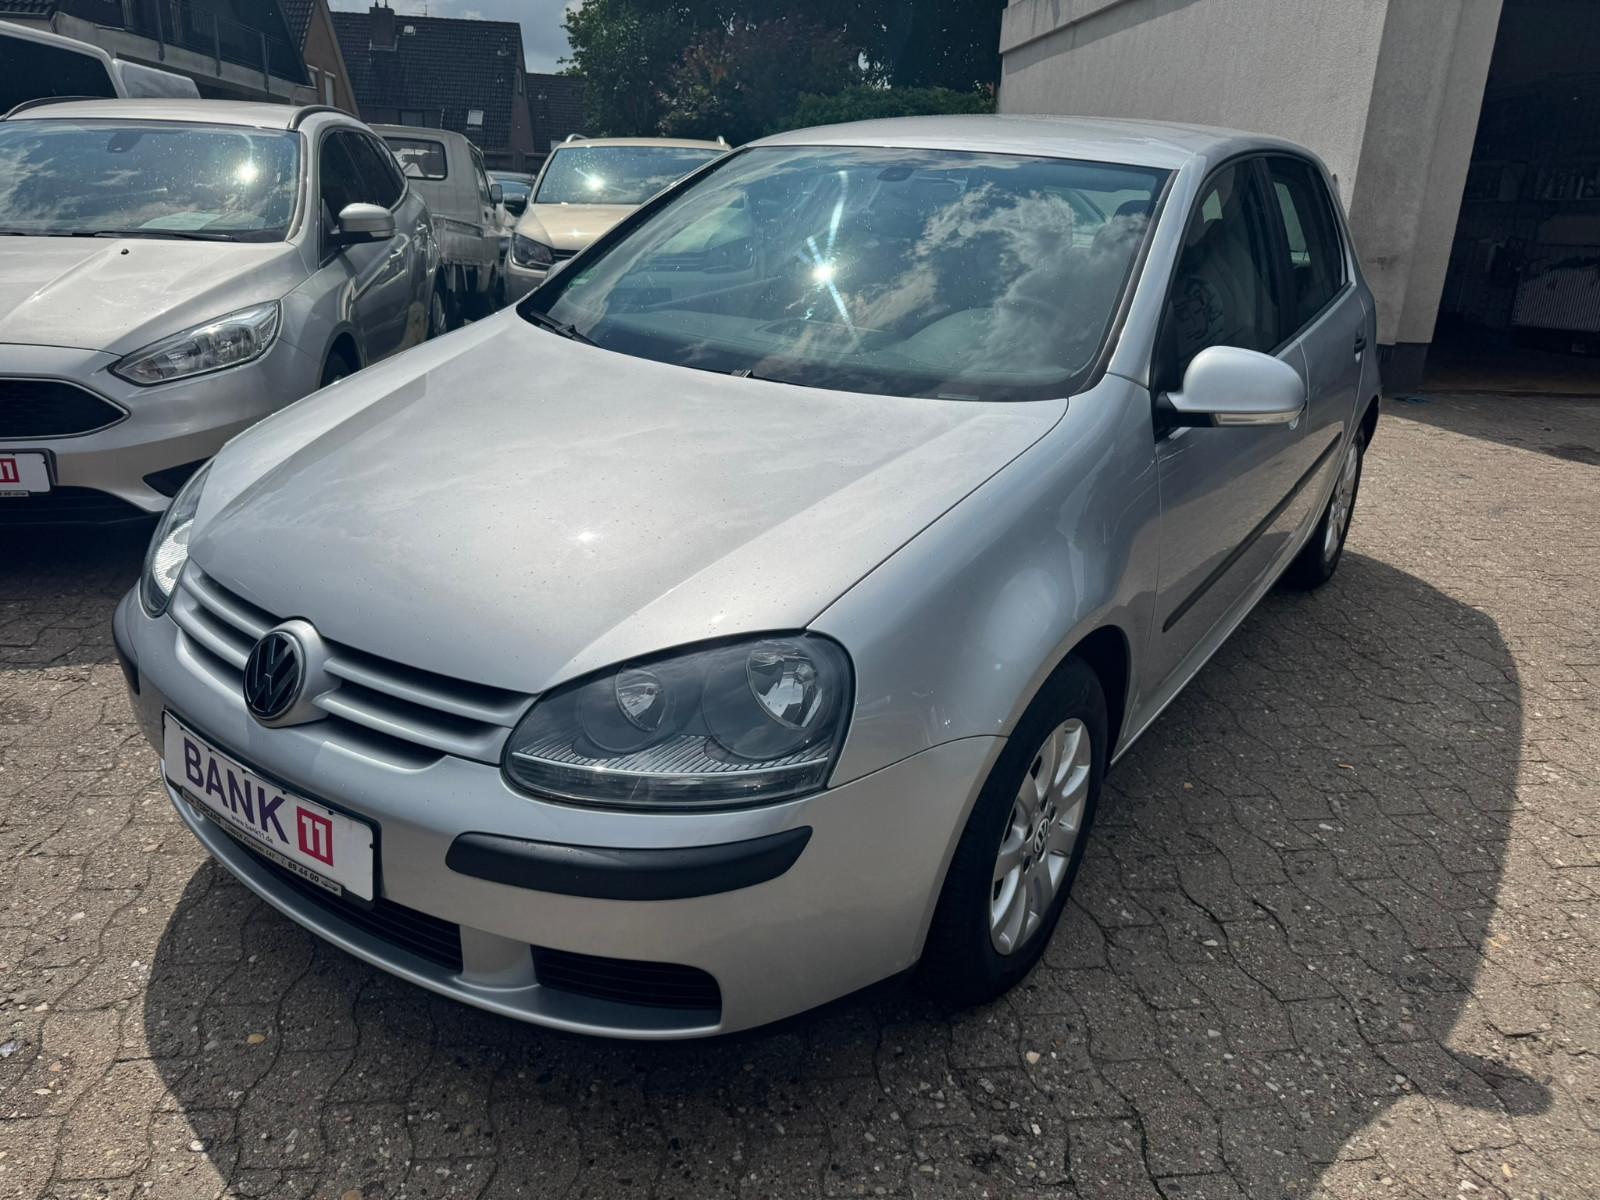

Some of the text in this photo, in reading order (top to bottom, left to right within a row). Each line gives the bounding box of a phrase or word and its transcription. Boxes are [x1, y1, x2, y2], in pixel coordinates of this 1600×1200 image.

[183, 736, 328, 860] BANK 11
[299, 868, 308, 877] 44
